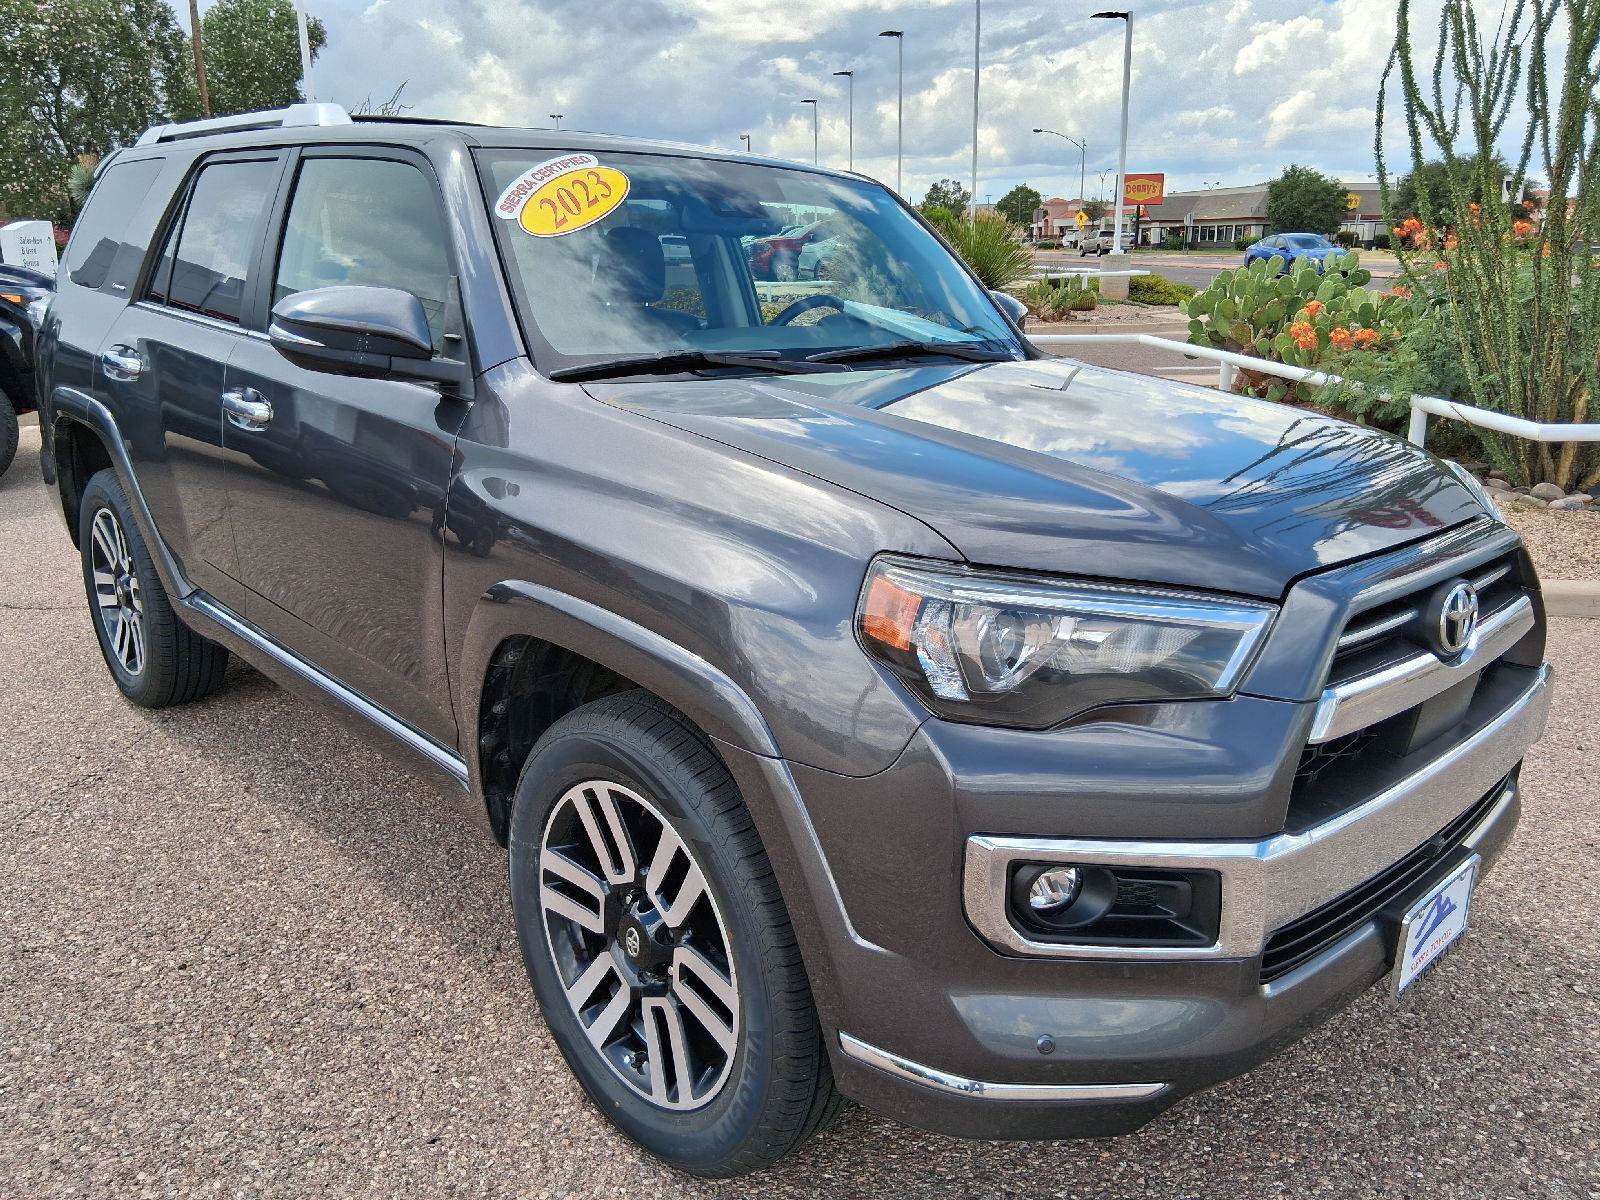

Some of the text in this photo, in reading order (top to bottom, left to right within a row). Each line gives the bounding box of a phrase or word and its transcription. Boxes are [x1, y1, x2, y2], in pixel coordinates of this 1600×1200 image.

[500, 155, 592, 214] SIERRA CERTIFIED
[540, 170, 612, 229] 2023
[1125, 183, 1158, 195] Denny's
